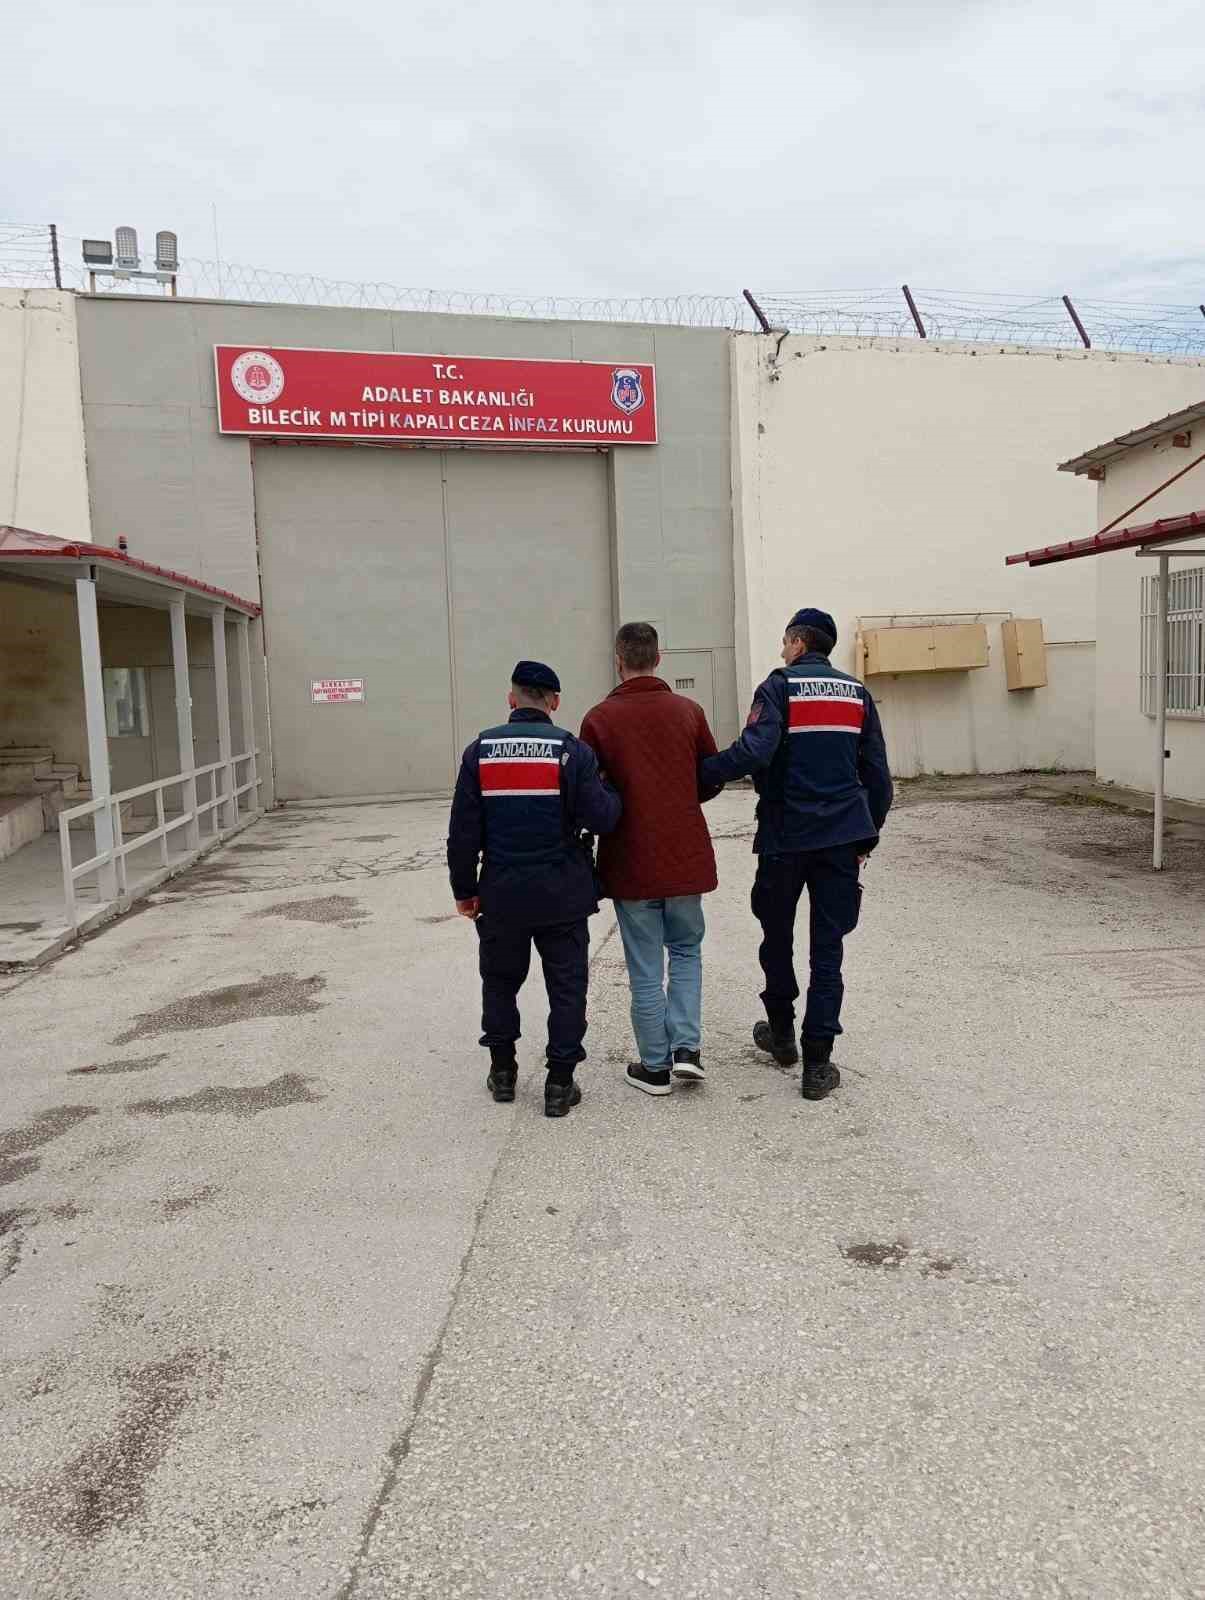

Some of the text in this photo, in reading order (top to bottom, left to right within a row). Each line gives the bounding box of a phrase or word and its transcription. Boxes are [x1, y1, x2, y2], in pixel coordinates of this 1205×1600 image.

[433, 364, 464, 380] T.C.
[361, 386, 534, 408] ADALET BAKANLIĞI
[248, 405, 634, 434] BİLECİK M TİPİ KAPALI CEZA İNFAZ KURUMU
[796, 681, 858, 699] JANDARMA
[487, 743, 553, 758] JANDARMA
